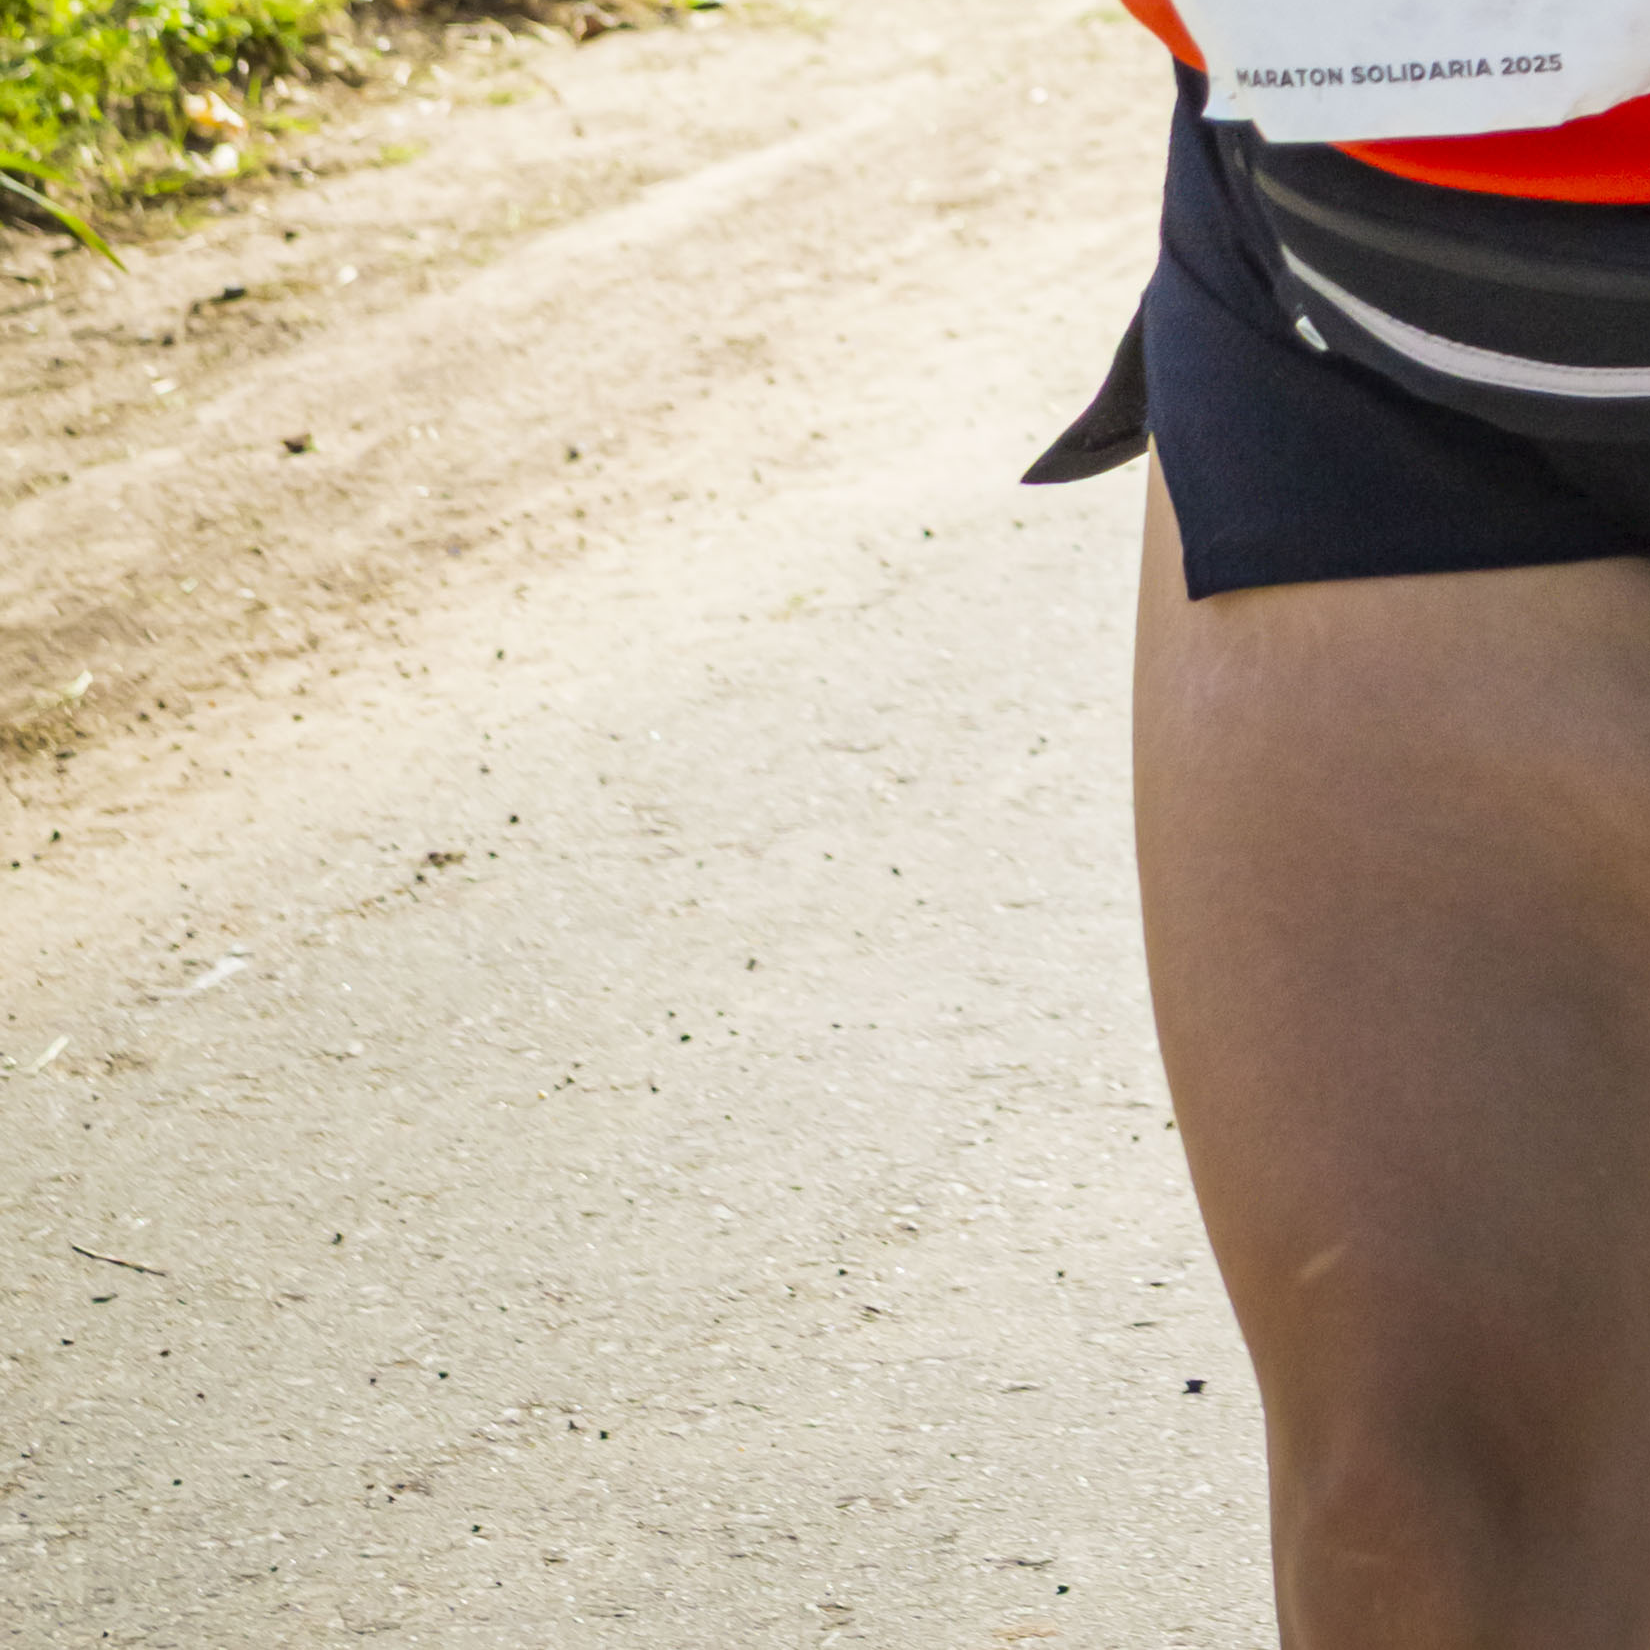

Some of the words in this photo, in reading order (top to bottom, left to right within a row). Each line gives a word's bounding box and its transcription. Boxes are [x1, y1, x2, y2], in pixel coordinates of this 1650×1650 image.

[1236, 67, 1344, 88] MARATON
[1350, 57, 1494, 85] SOLIDARIA
[1500, 53, 1564, 76] 2025
